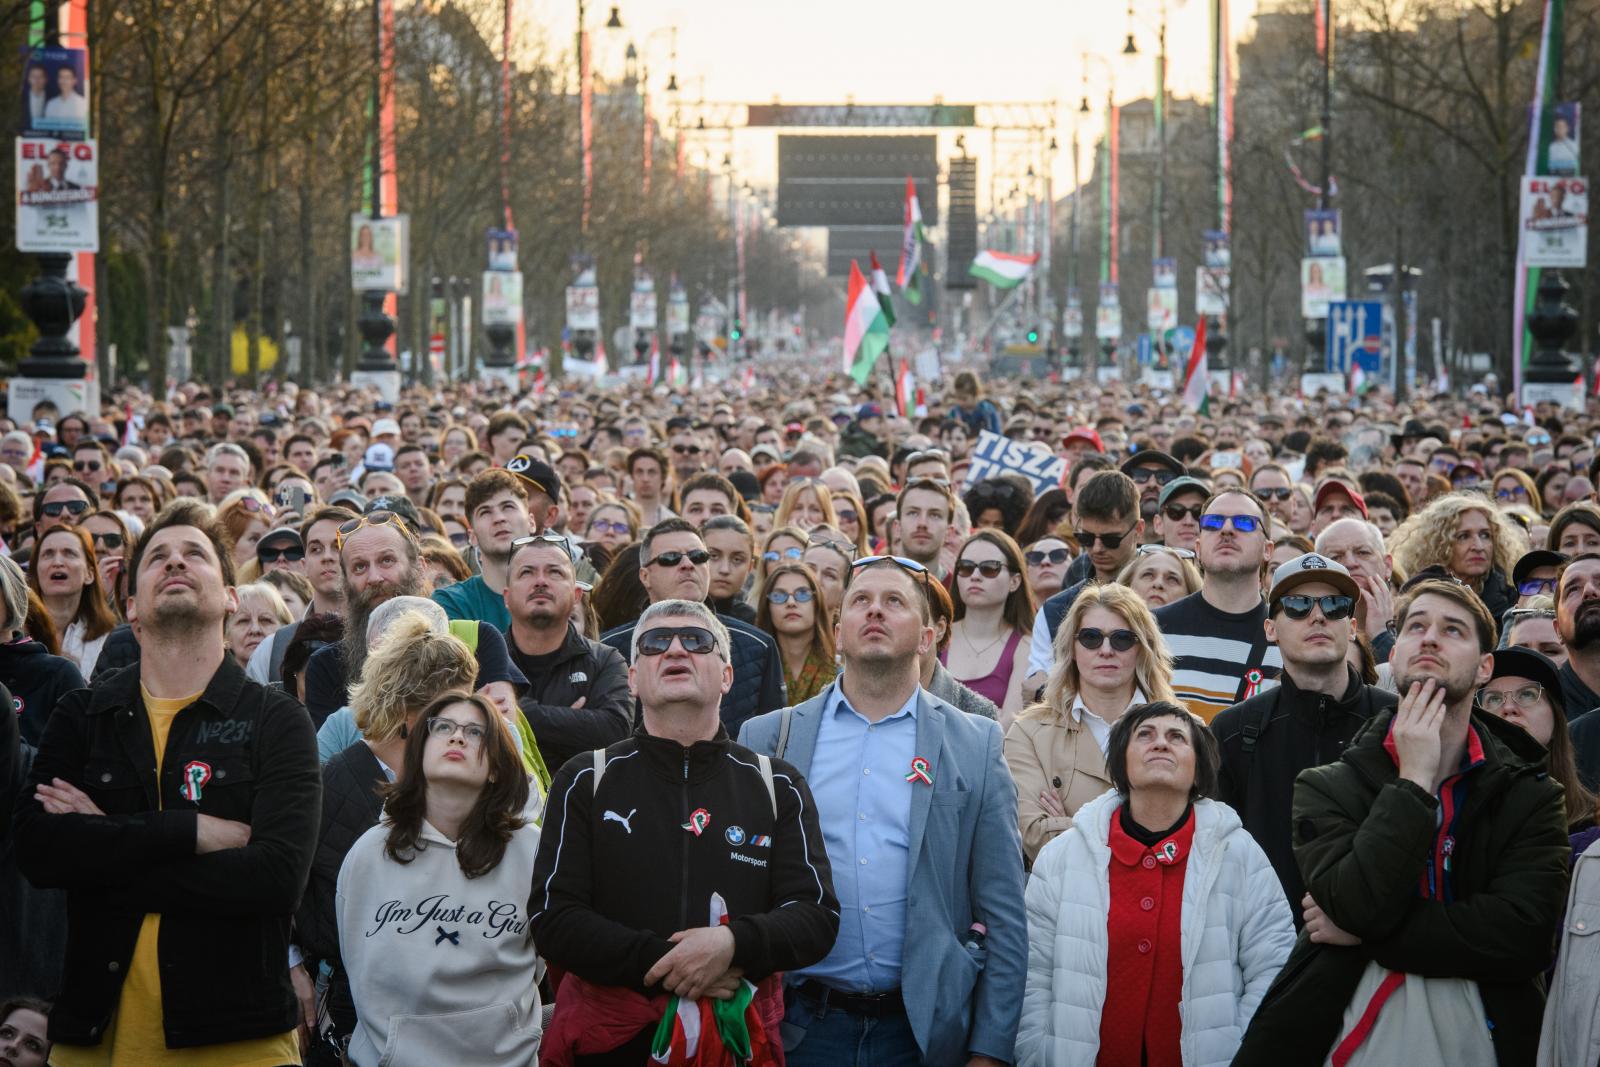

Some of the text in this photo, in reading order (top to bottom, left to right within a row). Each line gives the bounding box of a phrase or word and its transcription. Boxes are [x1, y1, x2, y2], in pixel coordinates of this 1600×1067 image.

[974, 429, 1068, 487] TISZA
[730, 851, 768, 868] Motorsport
[365, 894, 529, 939] I'm Just a Girl
